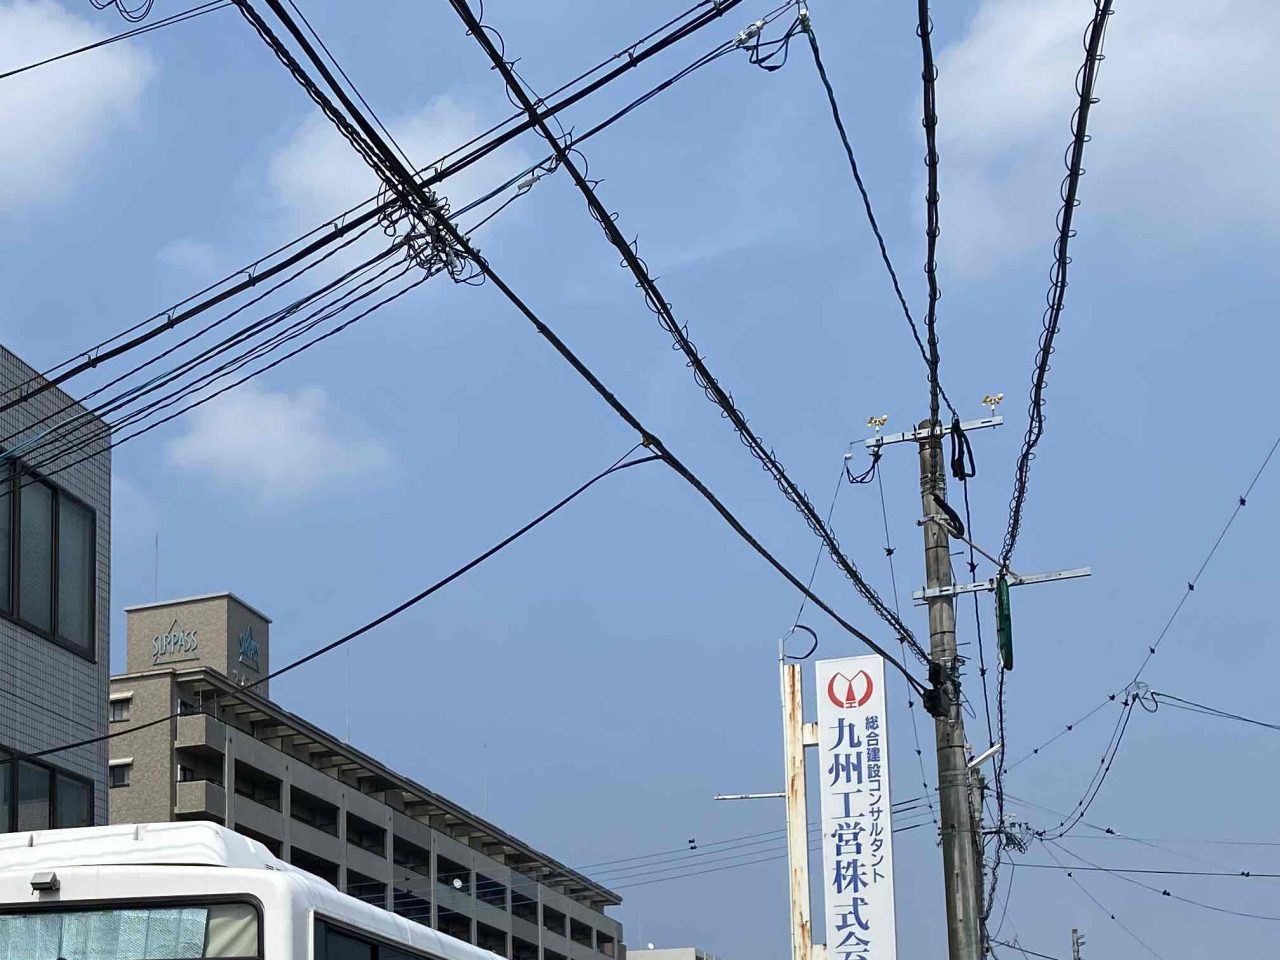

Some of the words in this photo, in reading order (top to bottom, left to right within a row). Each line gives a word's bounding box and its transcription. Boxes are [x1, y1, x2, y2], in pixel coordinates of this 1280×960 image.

[865, 716, 885, 884] 総合建設コンサルタント
